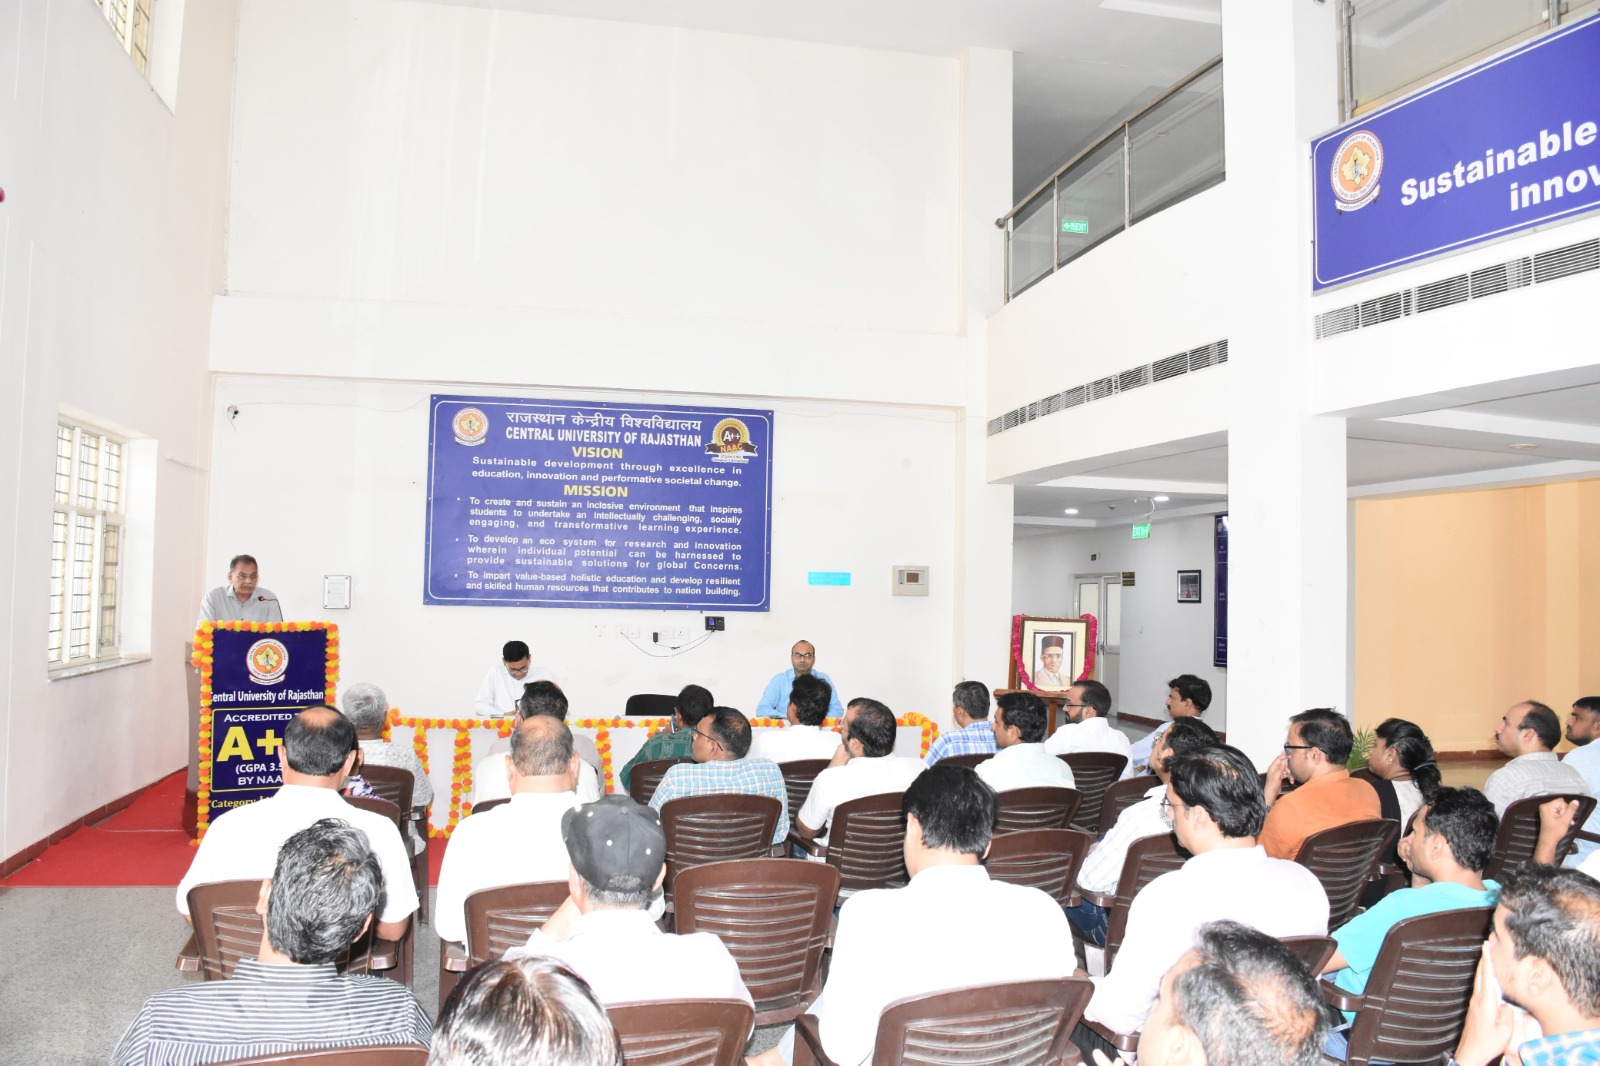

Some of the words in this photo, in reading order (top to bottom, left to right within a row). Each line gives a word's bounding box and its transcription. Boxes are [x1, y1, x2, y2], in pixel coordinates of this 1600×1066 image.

[1401, 121, 1597, 206] Sustainable
[1510, 164, 1600, 212] innov
[506, 412, 566, 425] राजस्थान
[571, 412, 615, 427] केन्द्रीय
[620, 413, 702, 431] विश्वविद्यालय
[506, 427, 554, 441] CENTRAL
[558, 429, 621, 443] UNIVERSITY
[624, 432, 637, 444] OF
[640, 433, 701, 447] RAJASTHAN
[723, 431, 741, 441] A++
[572, 446, 623, 458] VISION
[720, 443, 743, 453] NAAC
[472, 456, 537, 467] Sustainable
[544, 459, 613, 470] development
[620, 462, 662, 473] through
[669, 465, 725, 474] excellence
[472, 469, 523, 479] education,
[527, 471, 578, 480] innovation
[601, 474, 662, 483] performative
[665, 477, 702, 485] societal
[704, 478, 741, 488] change.
[564, 485, 628, 497] MISSION
[469, 497, 480, 505] To
[536, 500, 567, 508] sustain
[629, 503, 680, 511] environment
[710, 505, 743, 514] inspires
[470, 508, 507, 516] students
[528, 510, 570, 518] undertake
[594, 512, 646, 522] intellectually
[653, 513, 702, 524] challenging,
[711, 516, 741, 525] socially
[469, 519, 519, 529] engaging,
[554, 521, 628, 530] transformative
[639, 523, 679, 534] learning
[685, 525, 741, 534] experience.
[468, 534, 479, 543] To
[484, 535, 519, 544] develop
[563, 539, 597, 547] system
[604, 539, 616, 547] for
[695, 542, 741, 550] innovation
[468, 545, 507, 554] wherein
[518, 546, 566, 555] individual
[574, 549, 617, 557] potential
[675, 551, 723, 560] harnessed
[467, 556, 505, 565] provide
[515, 557, 573, 566] sustainable
[581, 559, 628, 567] solutions
[636, 560, 650, 568] for
[657, 561, 687, 570] global
[694, 561, 742, 571] Concerns.
[468, 571, 479, 579] To
[483, 571, 511, 580] impart
[515, 572, 566, 581] value-based
[571, 573, 601, 582] holistic
[606, 575, 647, 583] education
[670, 576, 703, 586] develop
[706, 577, 740, 585] resilient
[484, 582, 512, 590] skilled
[515, 582, 545, 591] human
[612, 585, 659, 593] contributes
[675, 586, 701, 594] nation
[705, 587, 740, 597] building.
[238, 690, 277, 703] University
[278, 690, 286, 700] of
[288, 689, 323, 703] Rajasthan
[224, 714, 292, 722] ACCREDITED
[236, 764, 266, 774] (CGPA
[238, 776, 254, 785] BY
